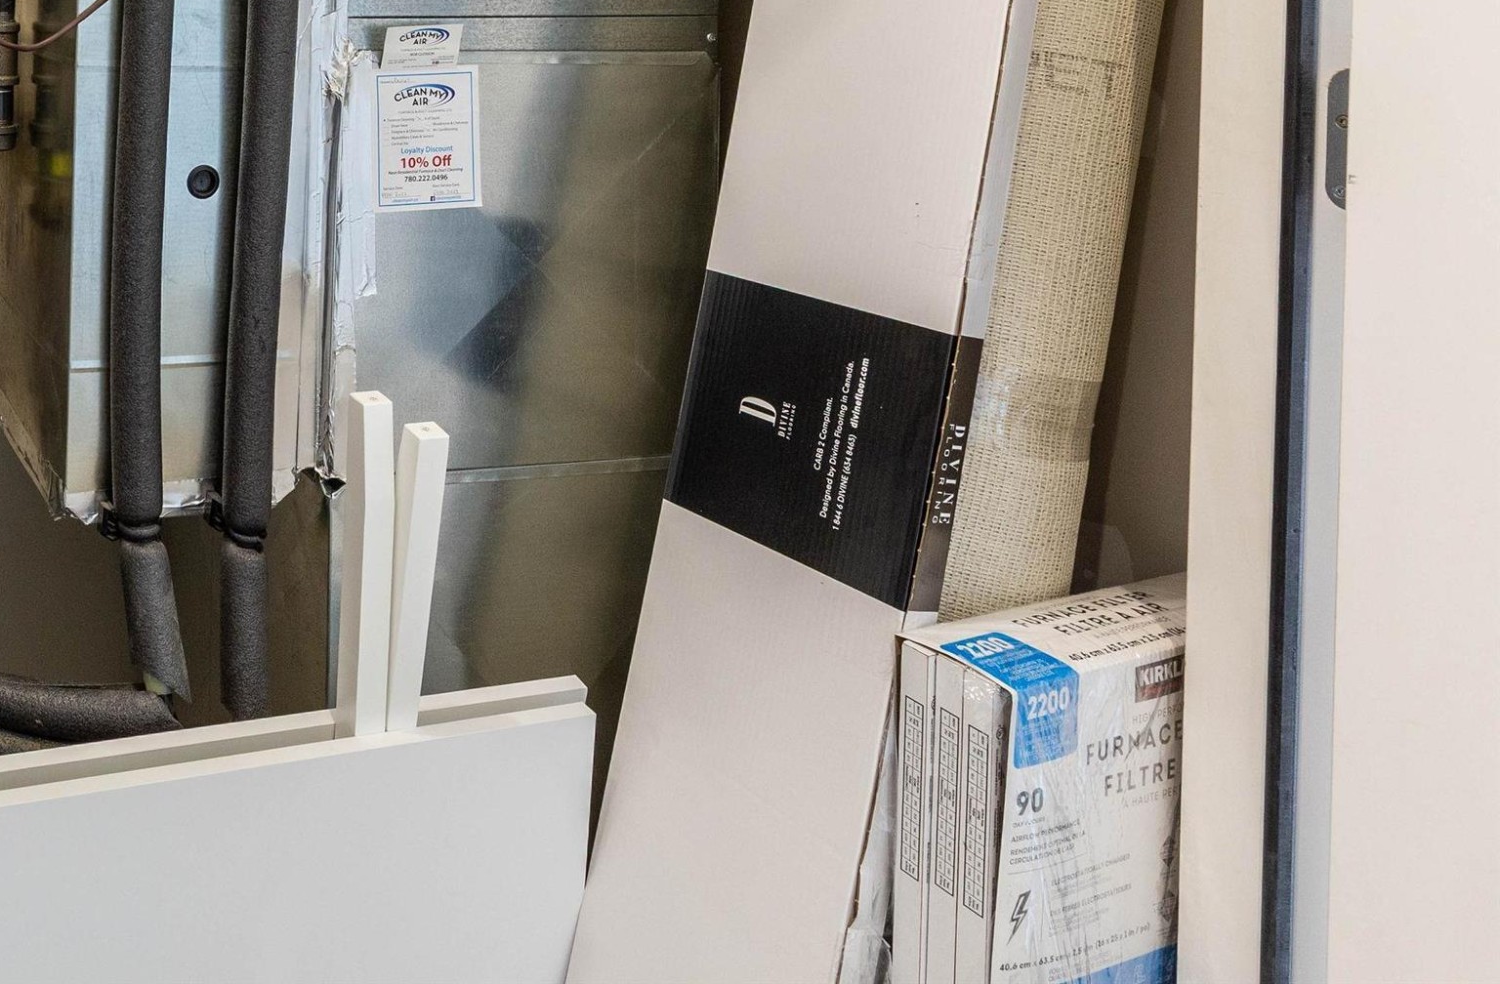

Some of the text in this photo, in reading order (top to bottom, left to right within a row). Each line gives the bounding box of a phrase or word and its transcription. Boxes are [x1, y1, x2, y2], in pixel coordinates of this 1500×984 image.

[399, 31, 428, 42] CLEAN
[413, 37, 427, 45] AIR
[394, 87, 445, 102] CLEAN MY
[412, 97, 429, 106] AIR
[401, 145, 453, 155] Loyalty Discount
[401, 154, 452, 168] 10% Off
[404, 174, 448, 182] 780.222.0496
[849, 357, 870, 430] divinefloor.com
[738, 396, 777, 428] D
[777, 400, 791, 438] DIVINE
[818, 397, 834, 440] Compliant.
[819, 360, 855, 519] Designed by Divine Flooring in Canada.
[813, 447, 826, 471] CARB
[842, 456, 853, 475] (634
[931, 423, 955, 525] FLOORING
[837, 473, 850, 504] DIVINE
[938, 424, 966, 525] DIVINE
[833, 510, 844, 526] 844
[1012, 590, 1155, 628] FURNACE FILTER
[1053, 612, 1120, 637] FILTRE
[1130, 602, 1170, 616] AIR
[957, 636, 1015, 658] 2200
[1027, 685, 1070, 721] 2200
[1085, 719, 1183, 766] FURNACE
[1104, 758, 1177, 797] FILTRE
[1016, 787, 1044, 816] 90
[999, 961, 1018, 972] 40.6
[1038, 954, 1056, 966] 63.5
